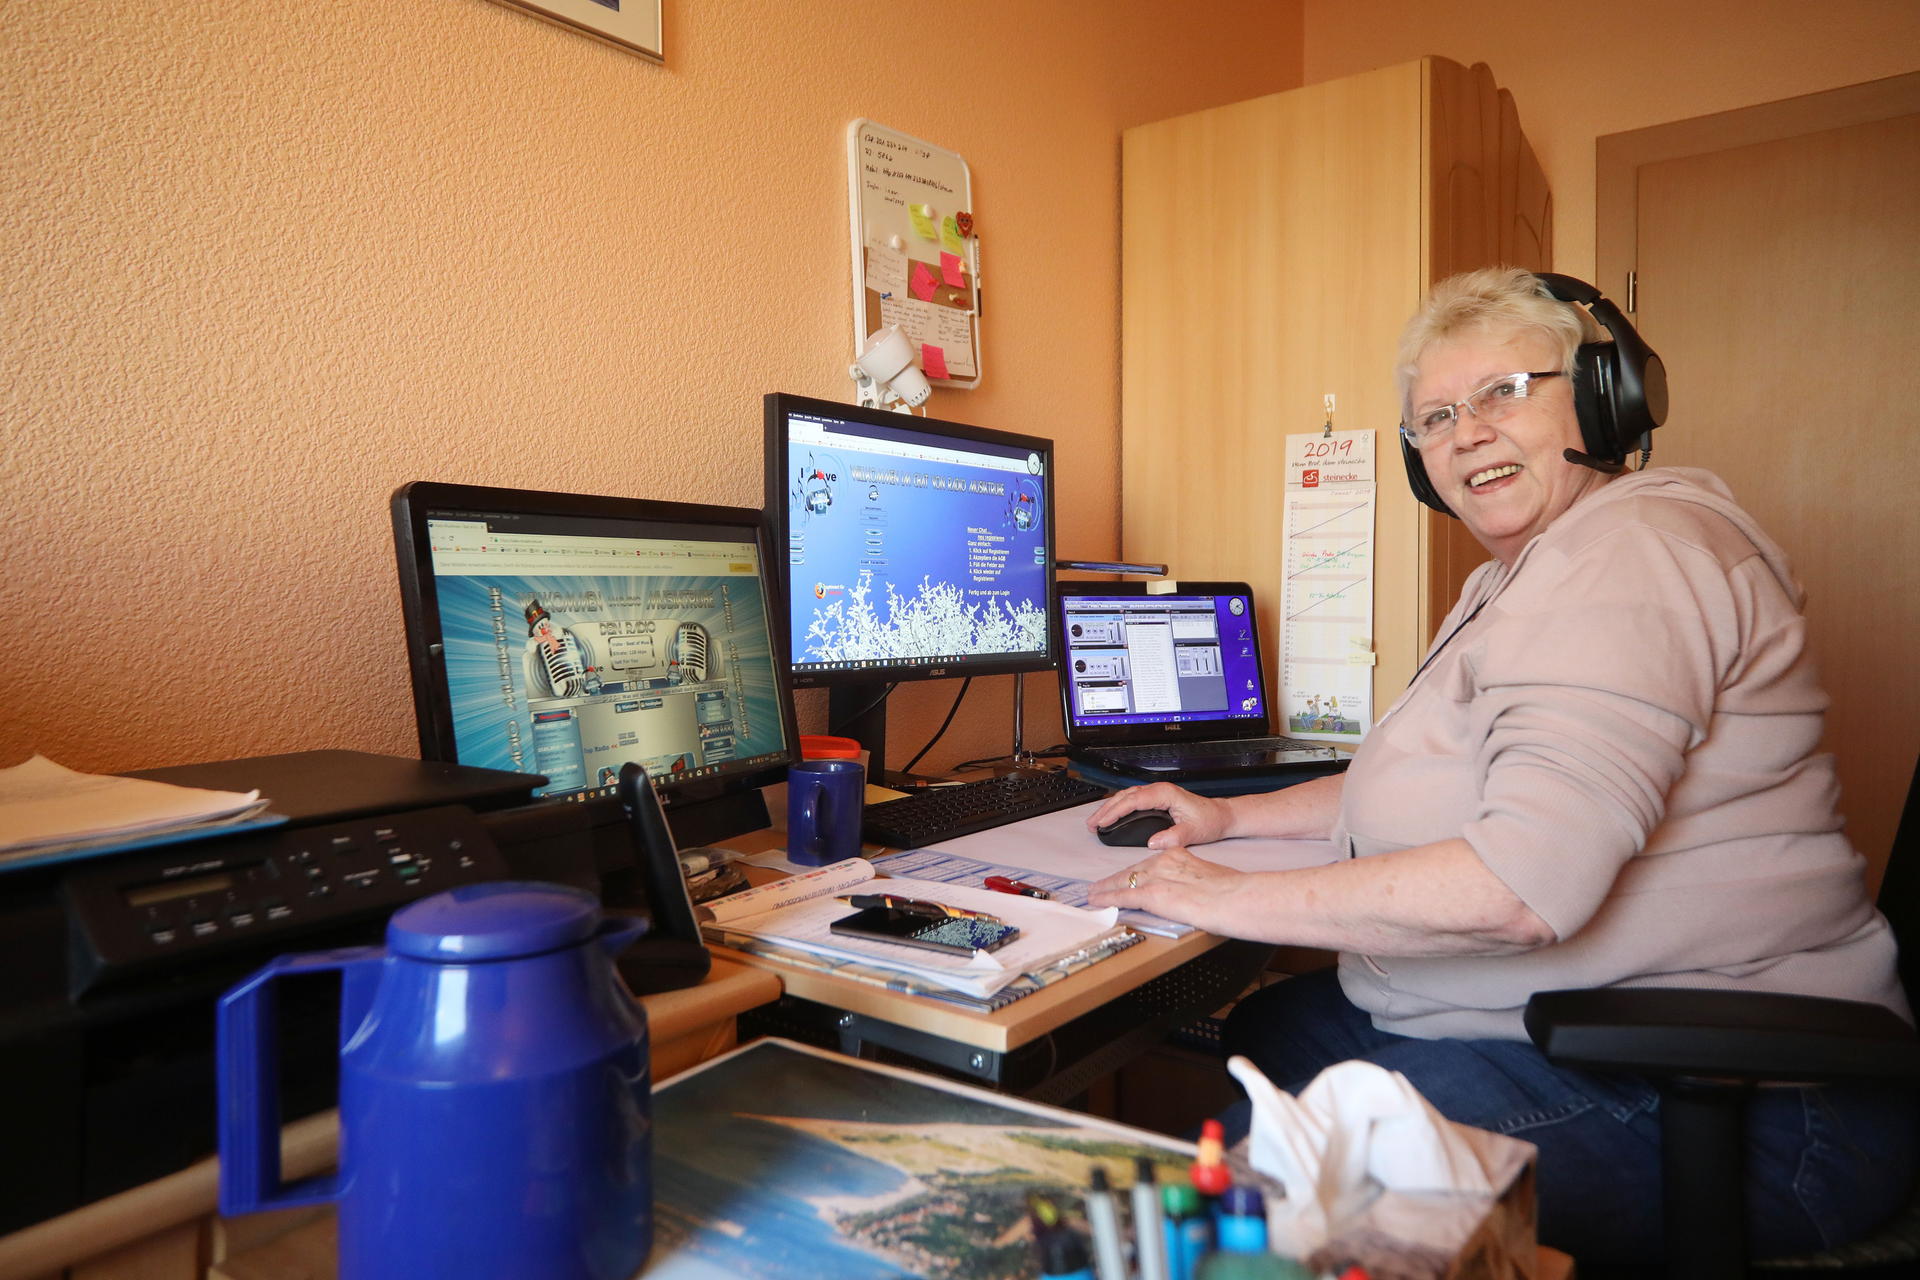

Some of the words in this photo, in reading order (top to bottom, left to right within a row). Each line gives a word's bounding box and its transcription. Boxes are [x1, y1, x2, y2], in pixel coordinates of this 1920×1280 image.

[1304, 439, 1353, 458] 2019
[813, 468, 837, 482] lve
[1323, 472, 1358, 481] steinecke
[599, 621, 623, 636] DEIN
[625, 620, 656, 635] RADIO
